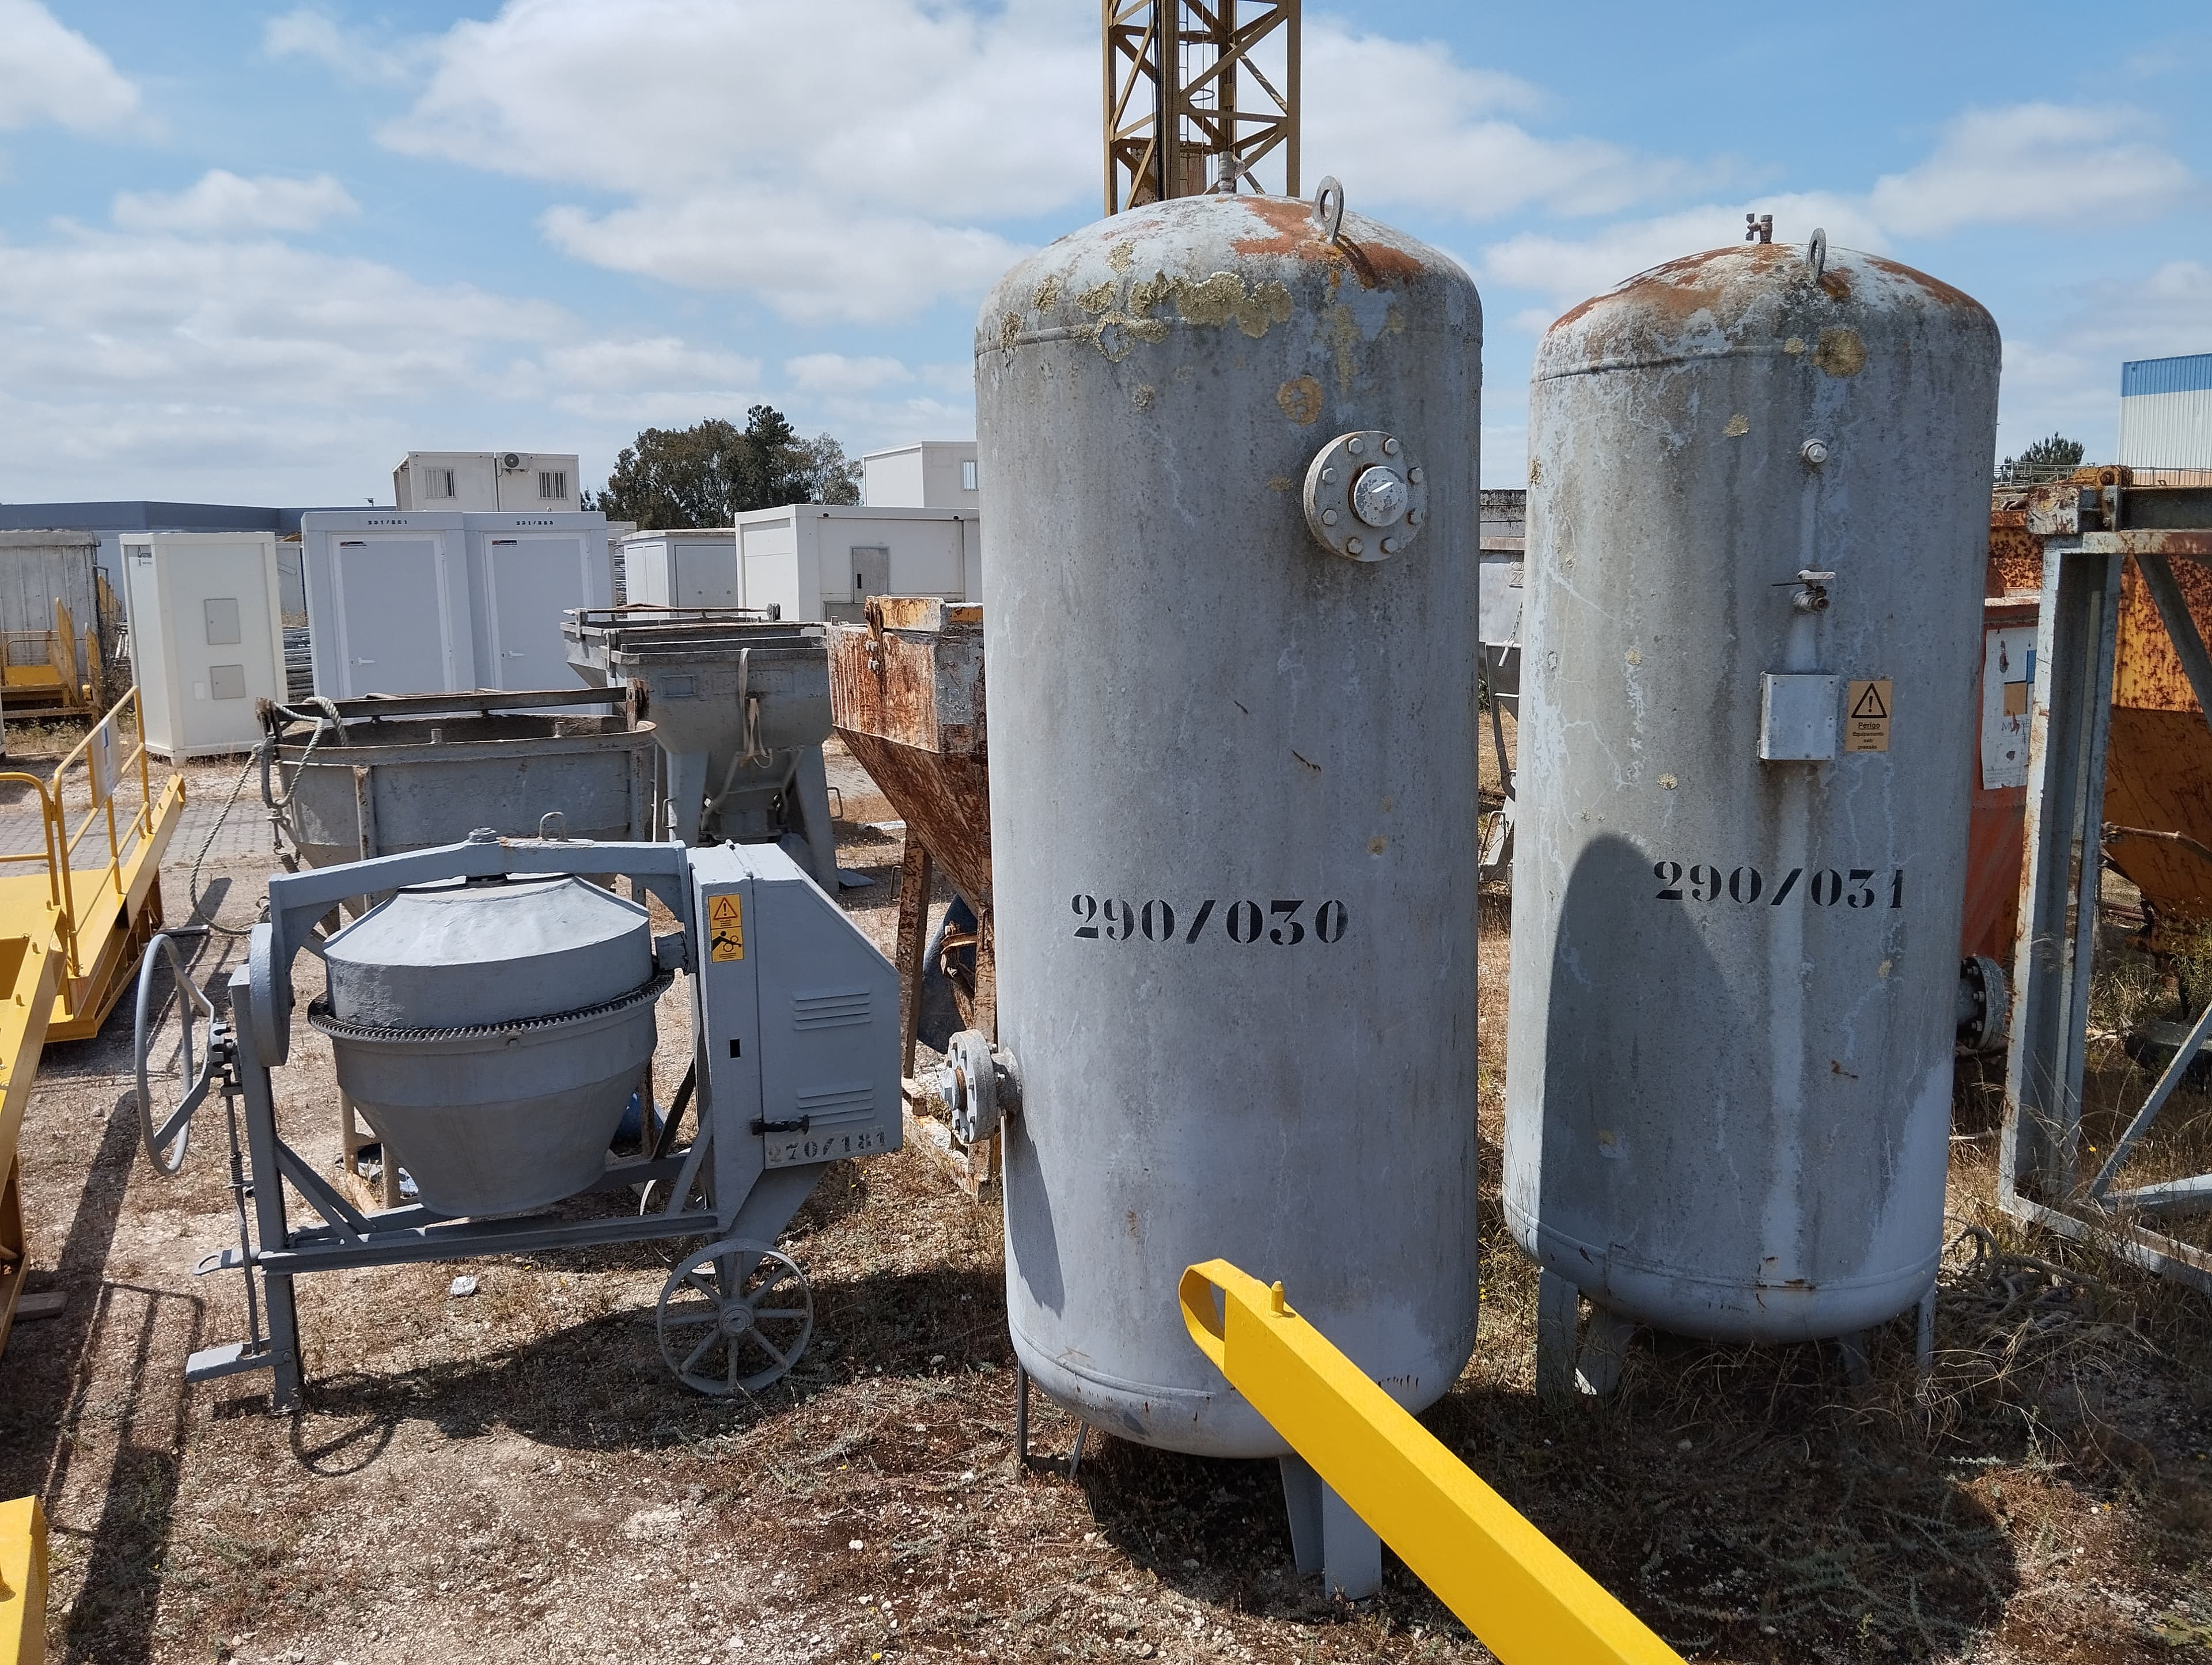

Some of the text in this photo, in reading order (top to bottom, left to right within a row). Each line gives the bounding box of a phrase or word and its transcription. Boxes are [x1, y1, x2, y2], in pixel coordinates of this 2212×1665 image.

[1858, 722, 1881, 730] Perigo
[1653, 860, 1904, 909] 290/031
[1070, 893, 1349, 946] 290/030
